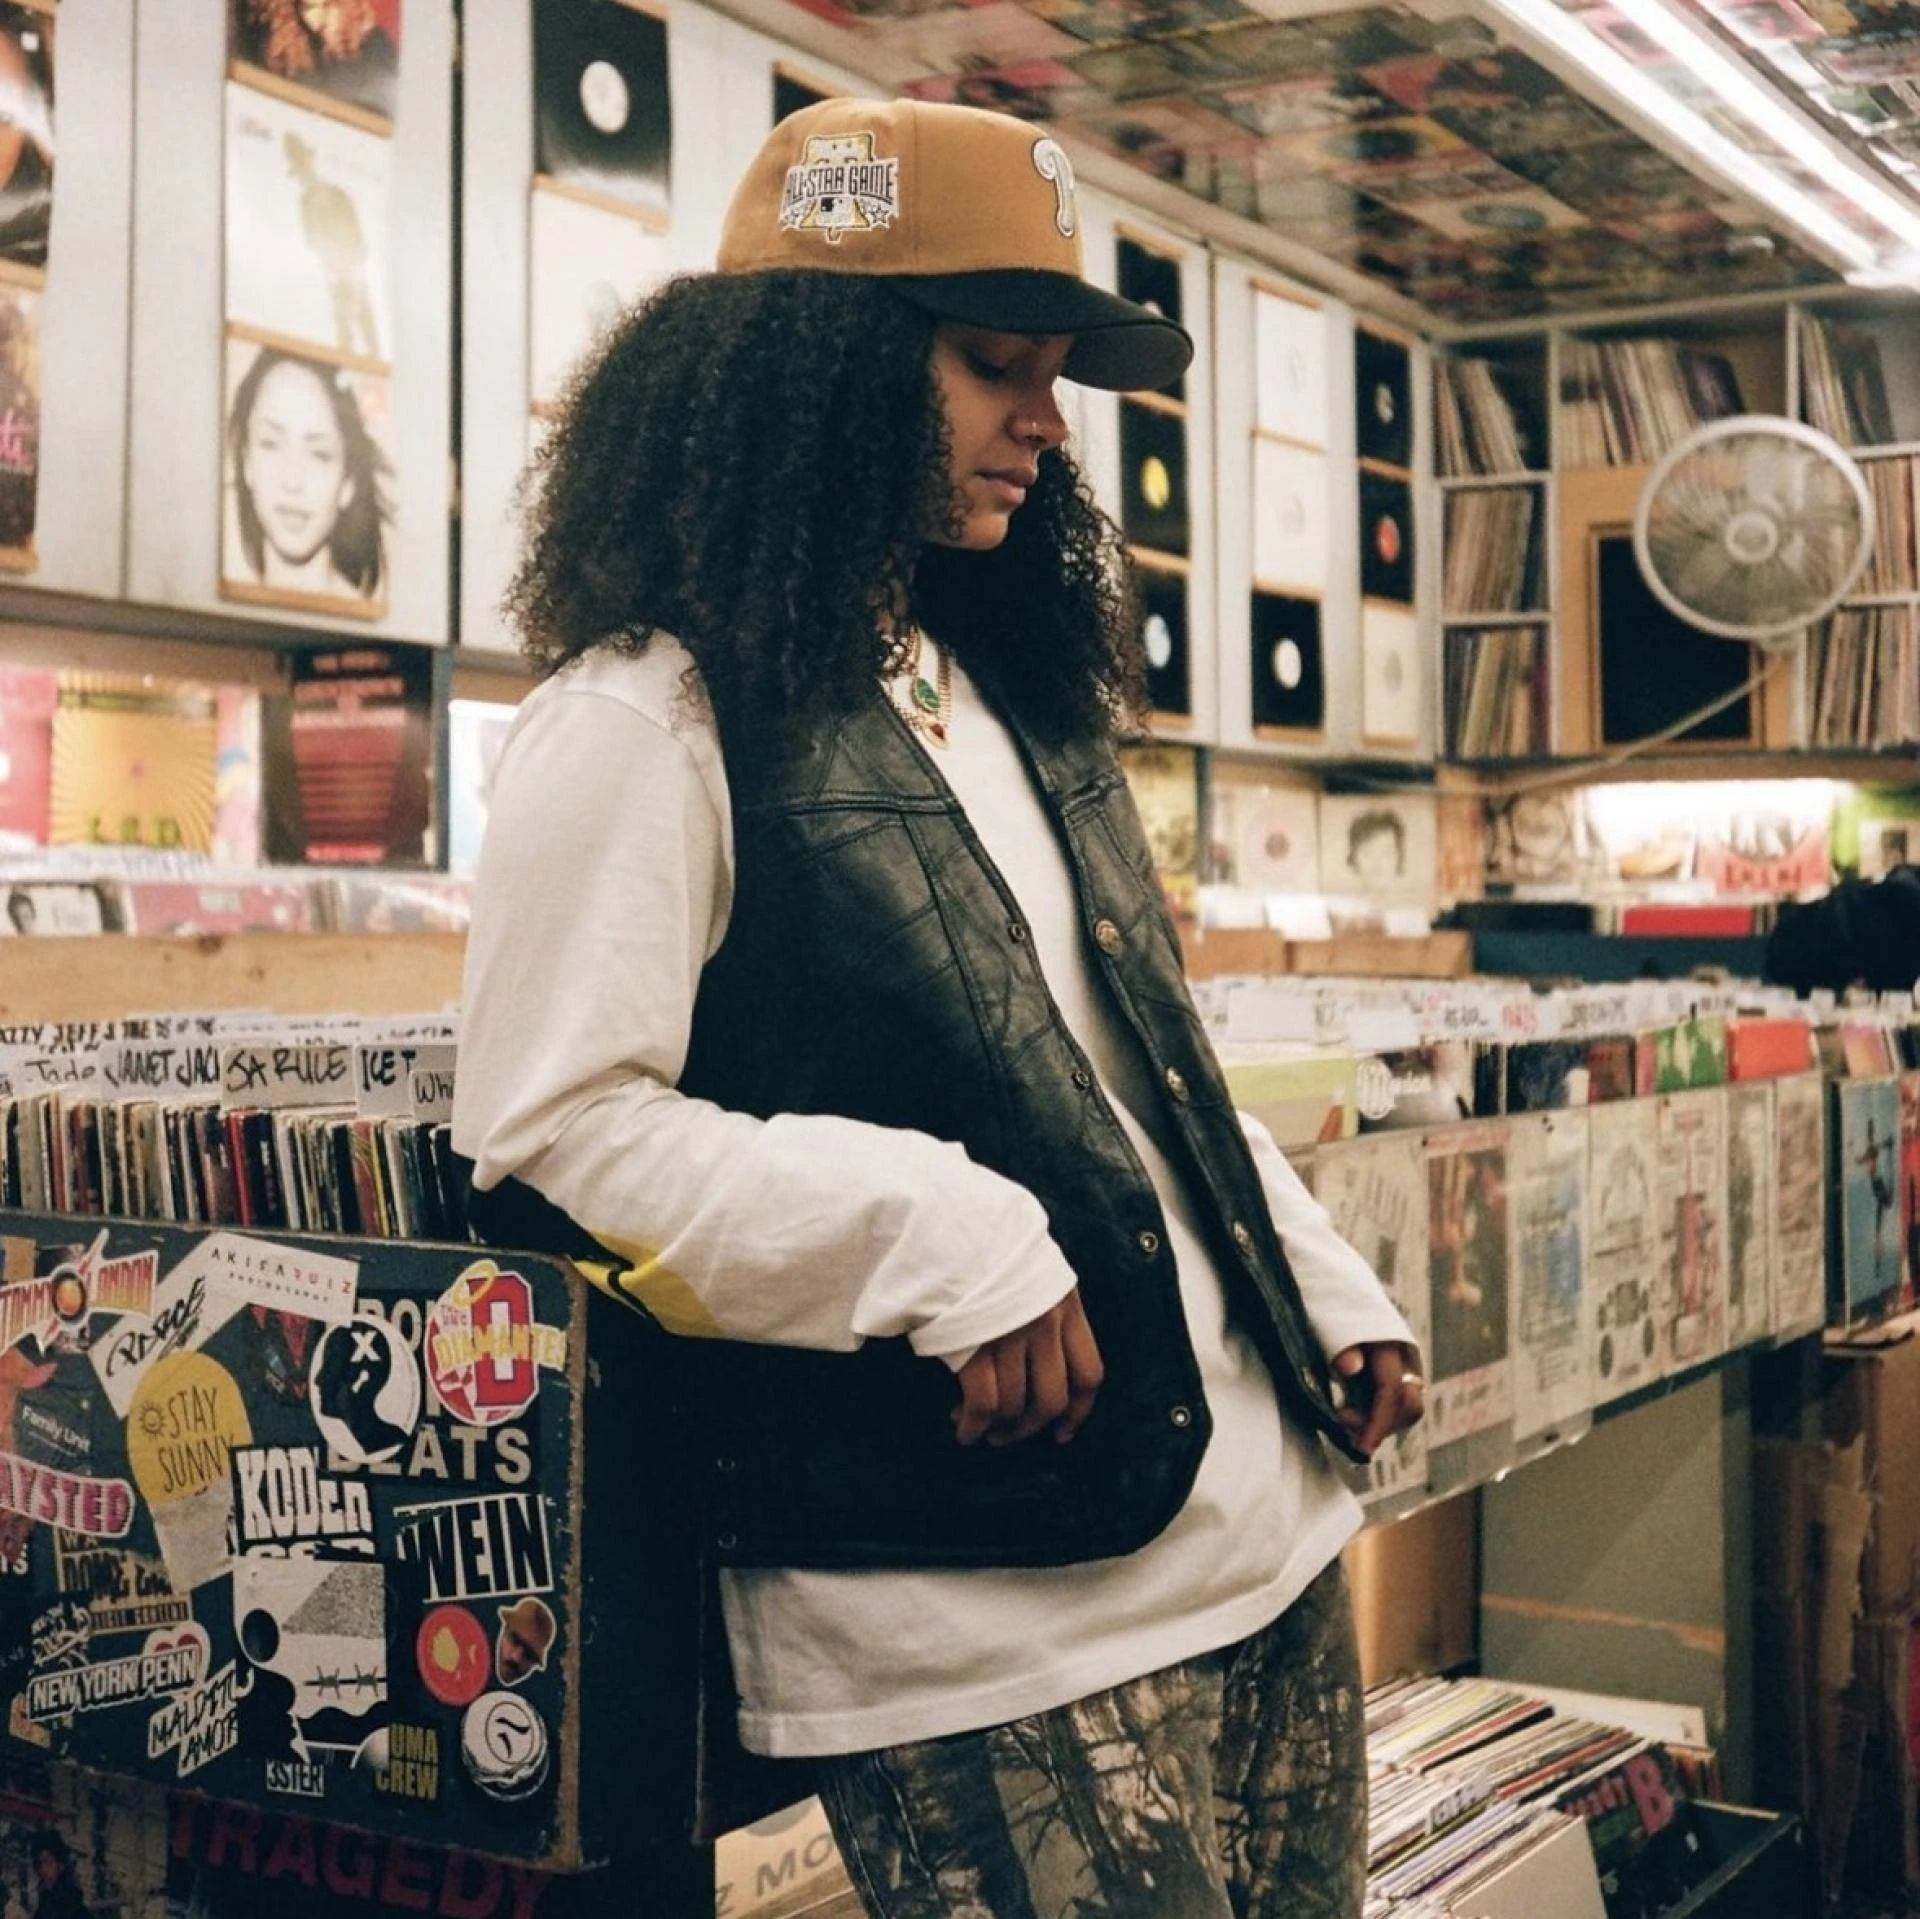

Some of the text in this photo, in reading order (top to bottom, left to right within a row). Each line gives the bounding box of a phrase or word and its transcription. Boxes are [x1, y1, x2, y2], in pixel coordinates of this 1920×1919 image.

[848, 162, 895, 203] GAME
[273, 1046, 347, 1085] RULE
[361, 1049, 397, 1092] ICE
[167, 1384, 218, 1439] STAY
[33, 1648, 195, 1712] NEW YORK PENN
[376, 1758, 438, 1799] CREW
